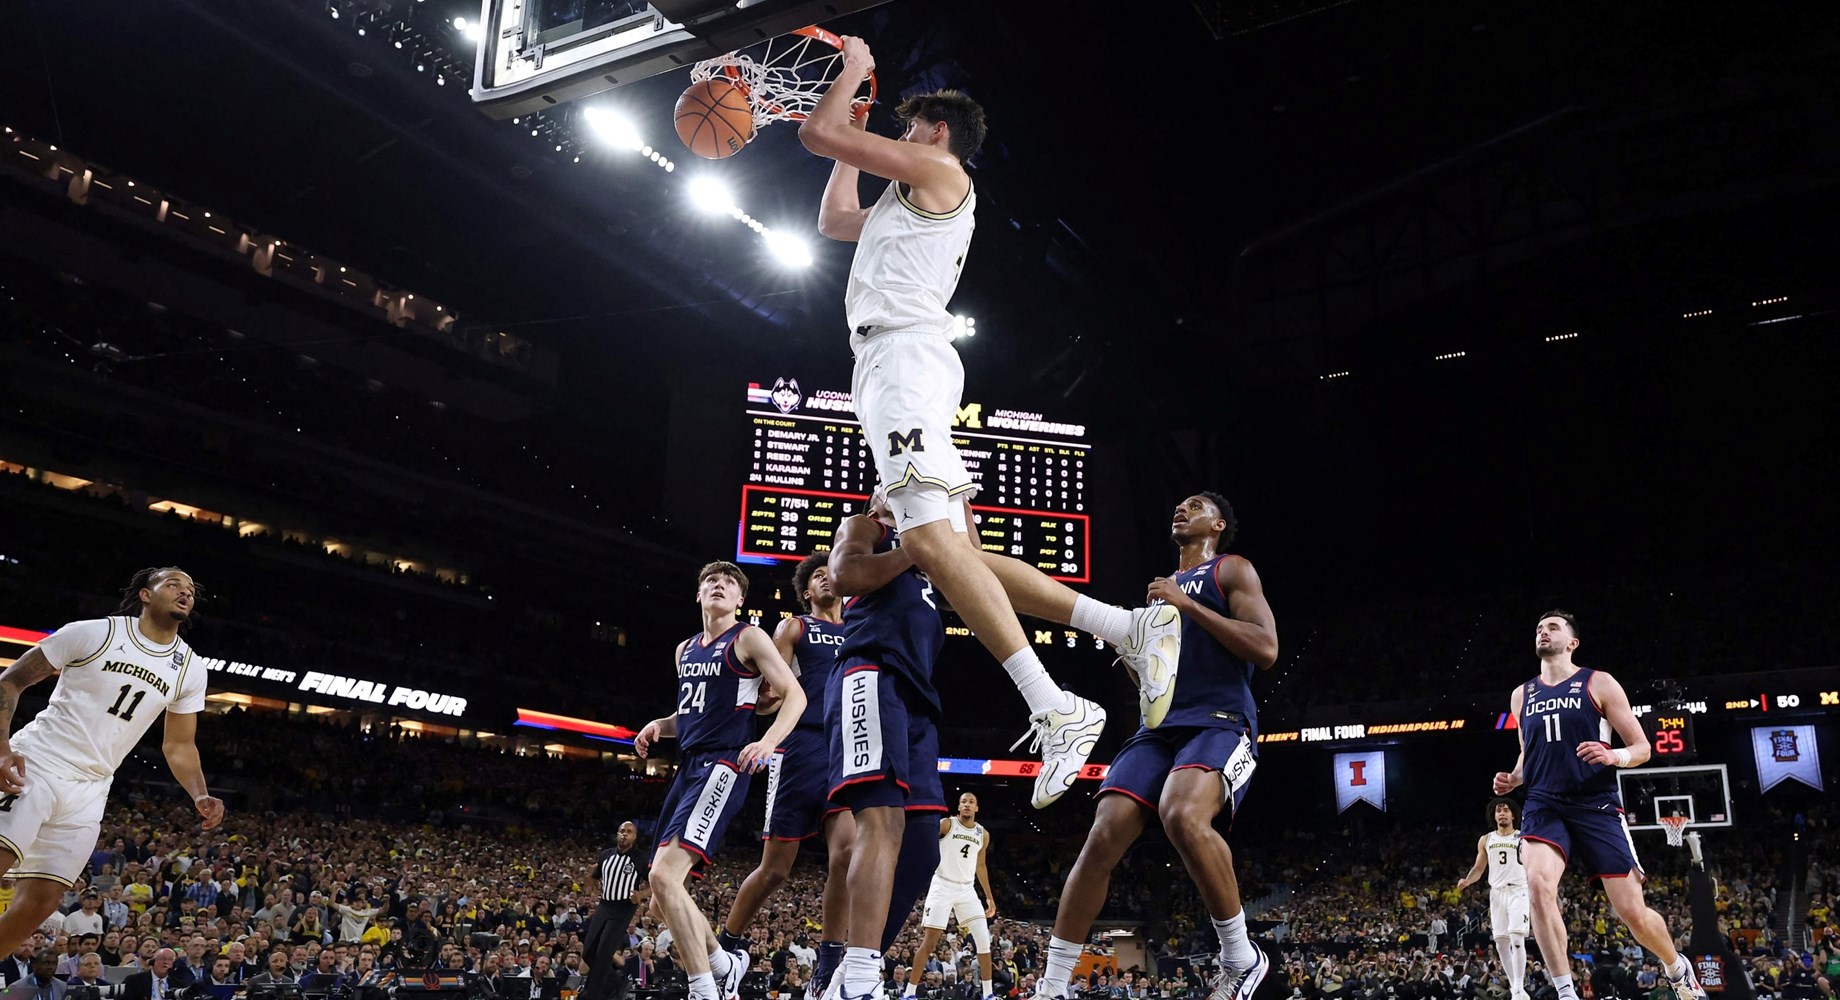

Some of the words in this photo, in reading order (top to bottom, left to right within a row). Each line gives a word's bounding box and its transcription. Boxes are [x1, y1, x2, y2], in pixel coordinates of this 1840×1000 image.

[816, 390, 852, 400] UCONN
[806, 397, 854, 412] HUSK
[951, 402, 982, 428] M
[995, 409, 1043, 421] MICHIGAN
[987, 416, 1085, 436] WOLVERINES
[768, 429, 806, 440] DEMARY
[807, 434, 820, 442] JR.
[888, 429, 924, 456] M
[767, 441, 810, 452] STEWART
[842, 448, 849, 456] 2
[766, 452, 791, 461] REED
[766, 463, 811, 475] KARABAN
[749, 473, 762, 481] 24
[765, 475, 804, 486] MULLINS
[781, 498, 809, 509] 17/54
[843, 503, 852, 513] 5
[781, 512, 798, 522] 39
[973, 514, 982, 524] 9
[781, 526, 797, 536] 22
[1013, 518, 1022, 528] 4
[1065, 522, 1074, 532] 6
[780, 540, 796, 550] 75
[1013, 531, 1022, 541] 11
[1065, 536, 1074, 545] 6
[1011, 545, 1023, 555] 21
[1064, 549, 1074, 559] 0
[1061, 563, 1077, 573] 30
[946, 627, 969, 636] 2ND
[1035, 631, 1052, 644] M
[808, 633, 846, 646] UCO
[1067, 638, 1075, 648] 3
[1095, 640, 1104, 650] 3
[678, 662, 722, 678] UCONN
[102, 660, 170, 697] MICHIGAN
[298, 671, 387, 703] FINAL
[388, 686, 468, 717] FOUR
[678, 681, 707, 715] 24
[1820, 692, 1839, 705] M
[106, 684, 147, 722] 11
[1526, 697, 1581, 717] UCONN
[1726, 701, 1749, 709] 2ND
[1777, 695, 1800, 708] 50
[852, 676, 869, 768] HUSKIES
[1542, 713, 1561, 742] 11
[1658, 718, 1684, 729] 7:44
[1265, 732, 1299, 742] MEN'S
[1301, 728, 1332, 742] FINAL
[1334, 724, 1365, 740] FOUR
[1367, 721, 1448, 734] INDIANAPOLIS,
[1451, 720, 1465, 729] IN
[1656, 730, 1684, 752] 25
[1350, 761, 1366, 786] I
[694, 770, 729, 841] HUSKIES
[952, 834, 980, 845] MICHIGAN
[960, 844, 970, 858] 4
[1499, 851, 1507, 864] 3
[1698, 962, 1720, 970] FINAL
[1700, 977, 1722, 986] FOUR
